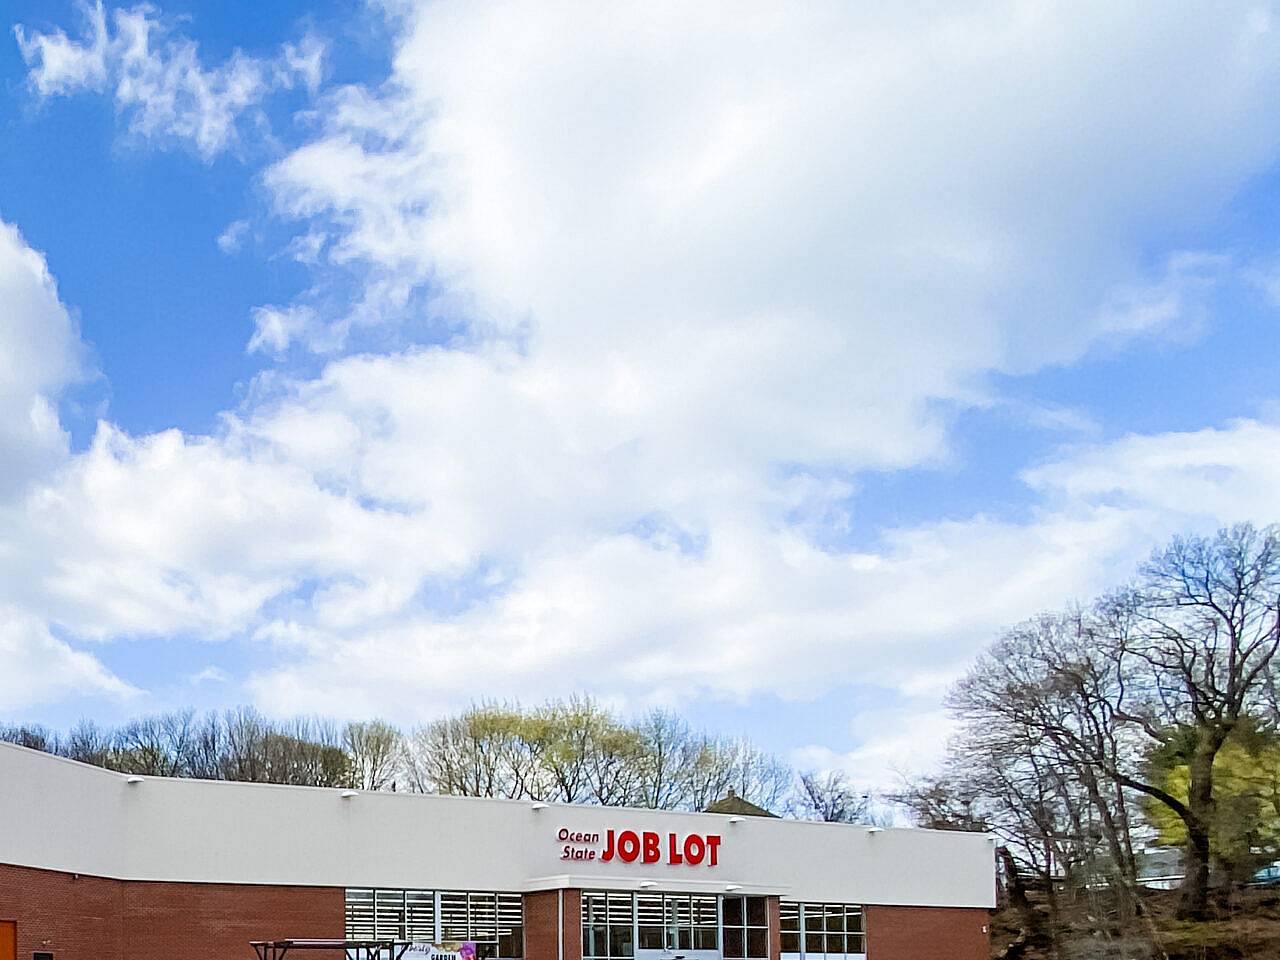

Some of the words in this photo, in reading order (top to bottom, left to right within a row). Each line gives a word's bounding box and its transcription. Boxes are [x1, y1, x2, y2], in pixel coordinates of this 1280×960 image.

[558, 828, 599, 843] Ocean
[562, 845, 596, 860] State
[601, 829, 661, 863] JOB
[668, 832, 721, 866] LOT
